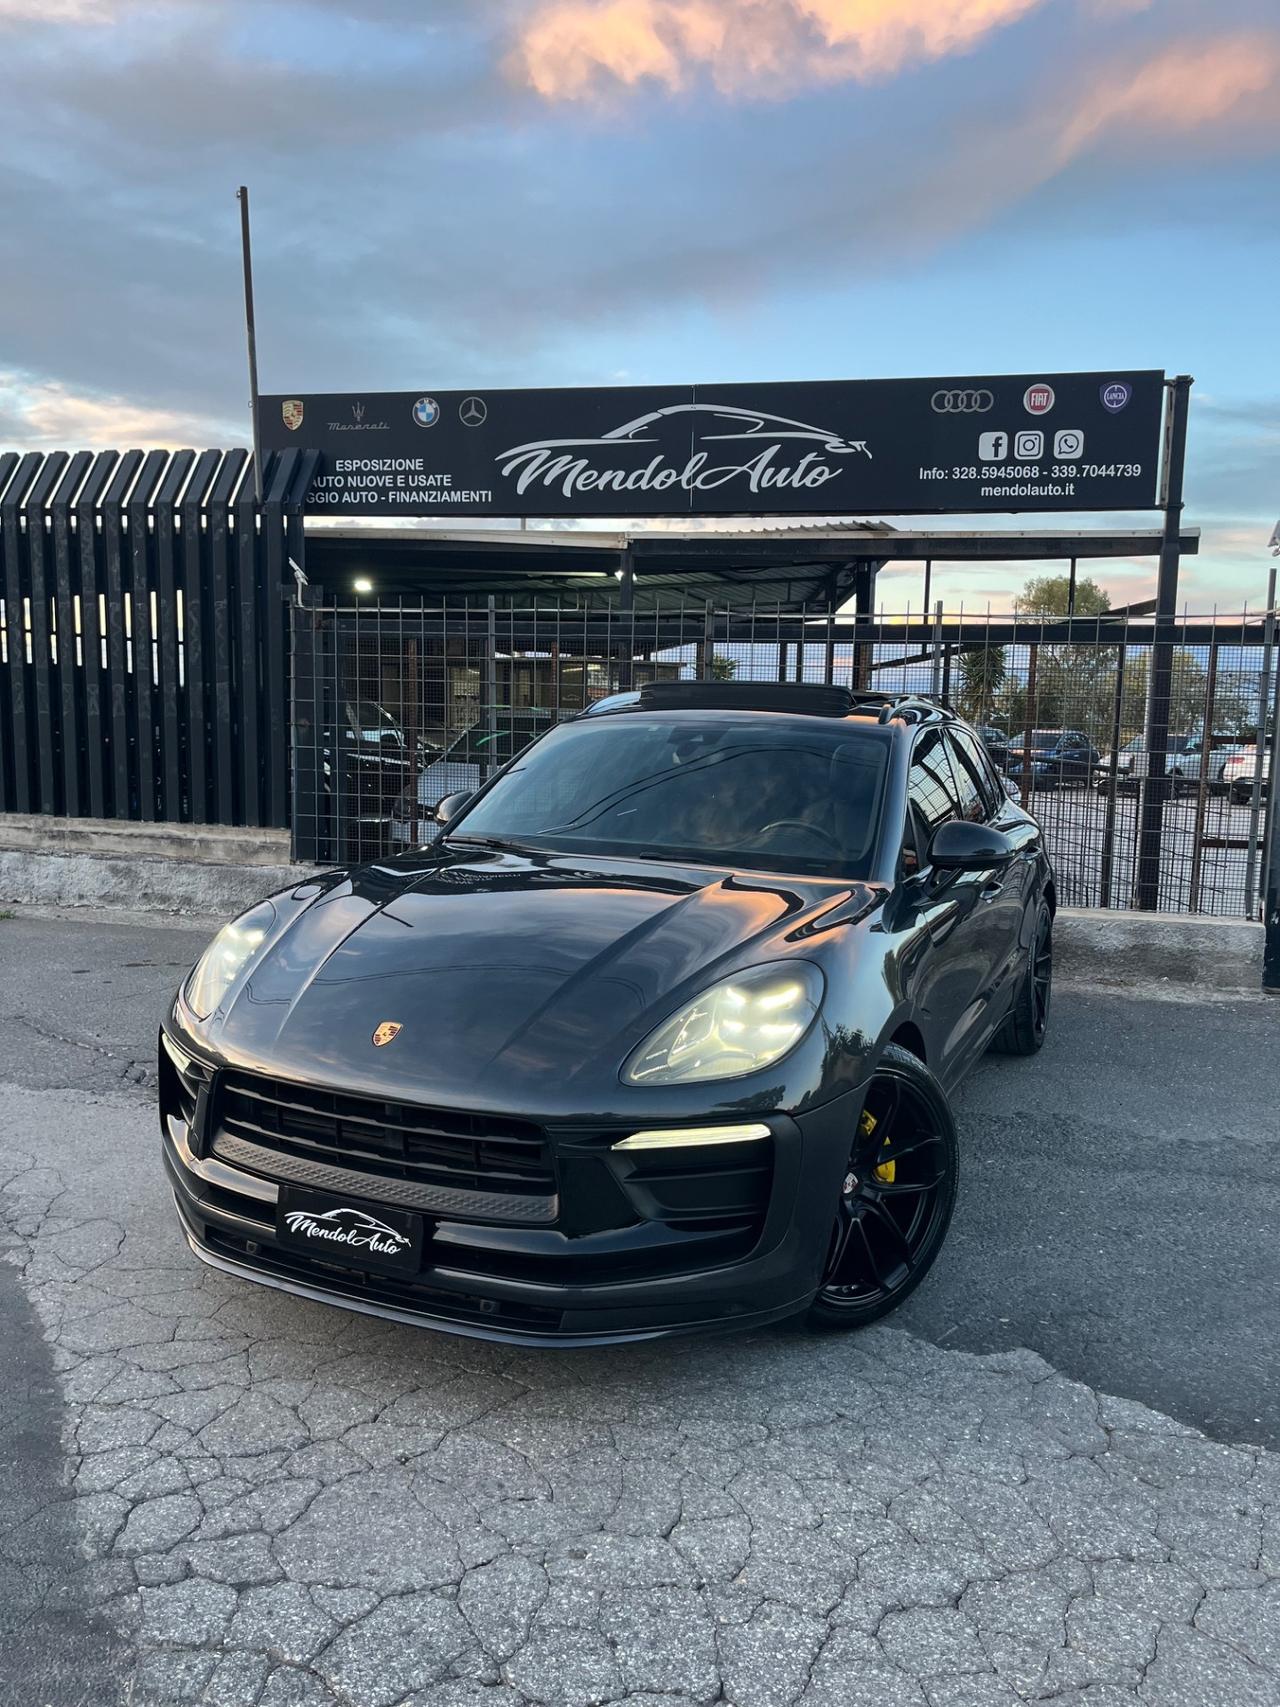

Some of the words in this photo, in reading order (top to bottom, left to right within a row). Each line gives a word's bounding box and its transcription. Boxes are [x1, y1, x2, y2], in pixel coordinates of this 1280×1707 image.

[1031, 392, 1049, 407] FIAT
[326, 421, 390, 431] Maserati
[335, 458, 424, 472] ESPOSIZIONE
[919, 466, 949, 480] Info:
[951, 465, 1040, 480] 328.5945068
[1050, 463, 1142, 478] 339.7044739
[347, 475, 394, 488] NUOVE
[396, 475, 406, 487] E
[408, 474, 452, 487] USATE
[980, 482, 1075, 497] mendolauto.it
[341, 491, 379, 504] AUTO
[388, 490, 492, 503] FINANZIAMENTI
